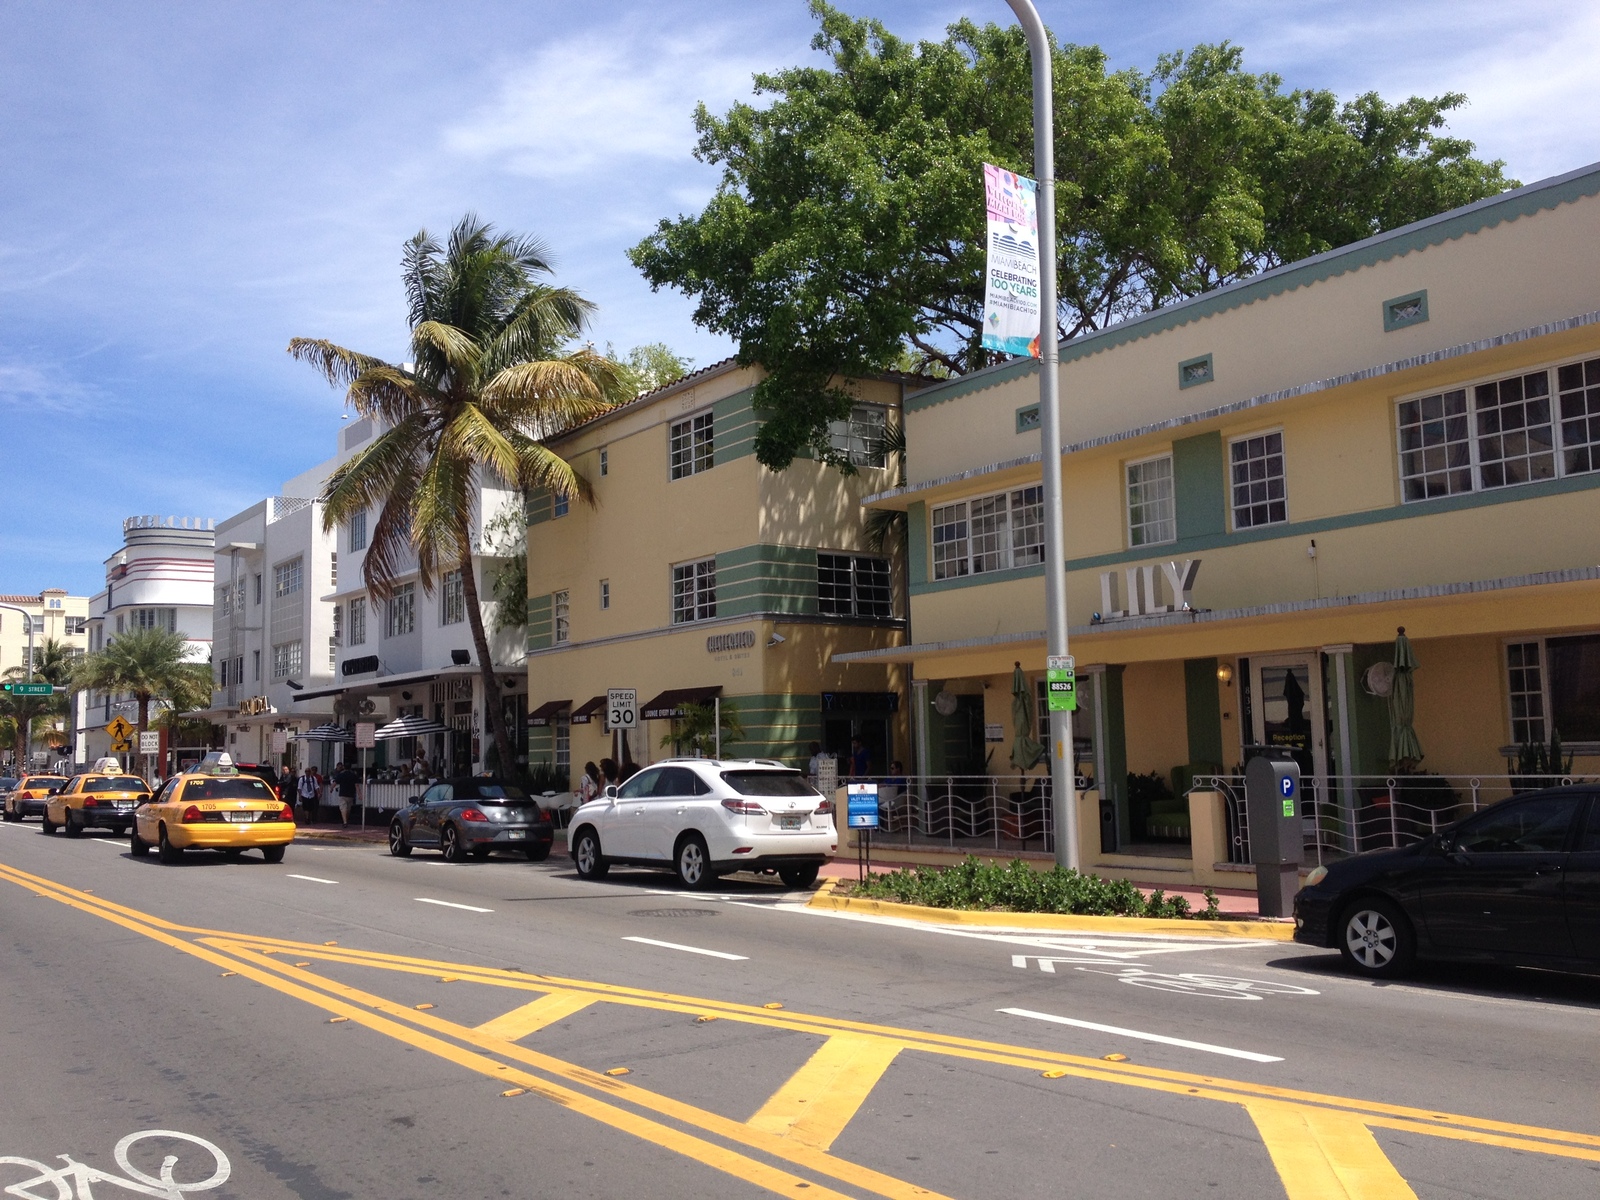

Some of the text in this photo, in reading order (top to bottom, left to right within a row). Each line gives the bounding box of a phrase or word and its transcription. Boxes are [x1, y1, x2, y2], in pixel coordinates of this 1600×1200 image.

[991, 254, 1037, 275] MIAMIBEACH
[990, 268, 1037, 288] CELEBRATING
[990, 277, 1037, 298] 100 YEARS
[1100, 559, 1203, 619] LILY
[610, 692, 634, 700] SPEED
[611, 709, 634, 724] 30
[644, 709, 658, 718] LOUNGE
[1272, 733, 1306, 742] Reception
[1282, 778, 1291, 794] P
